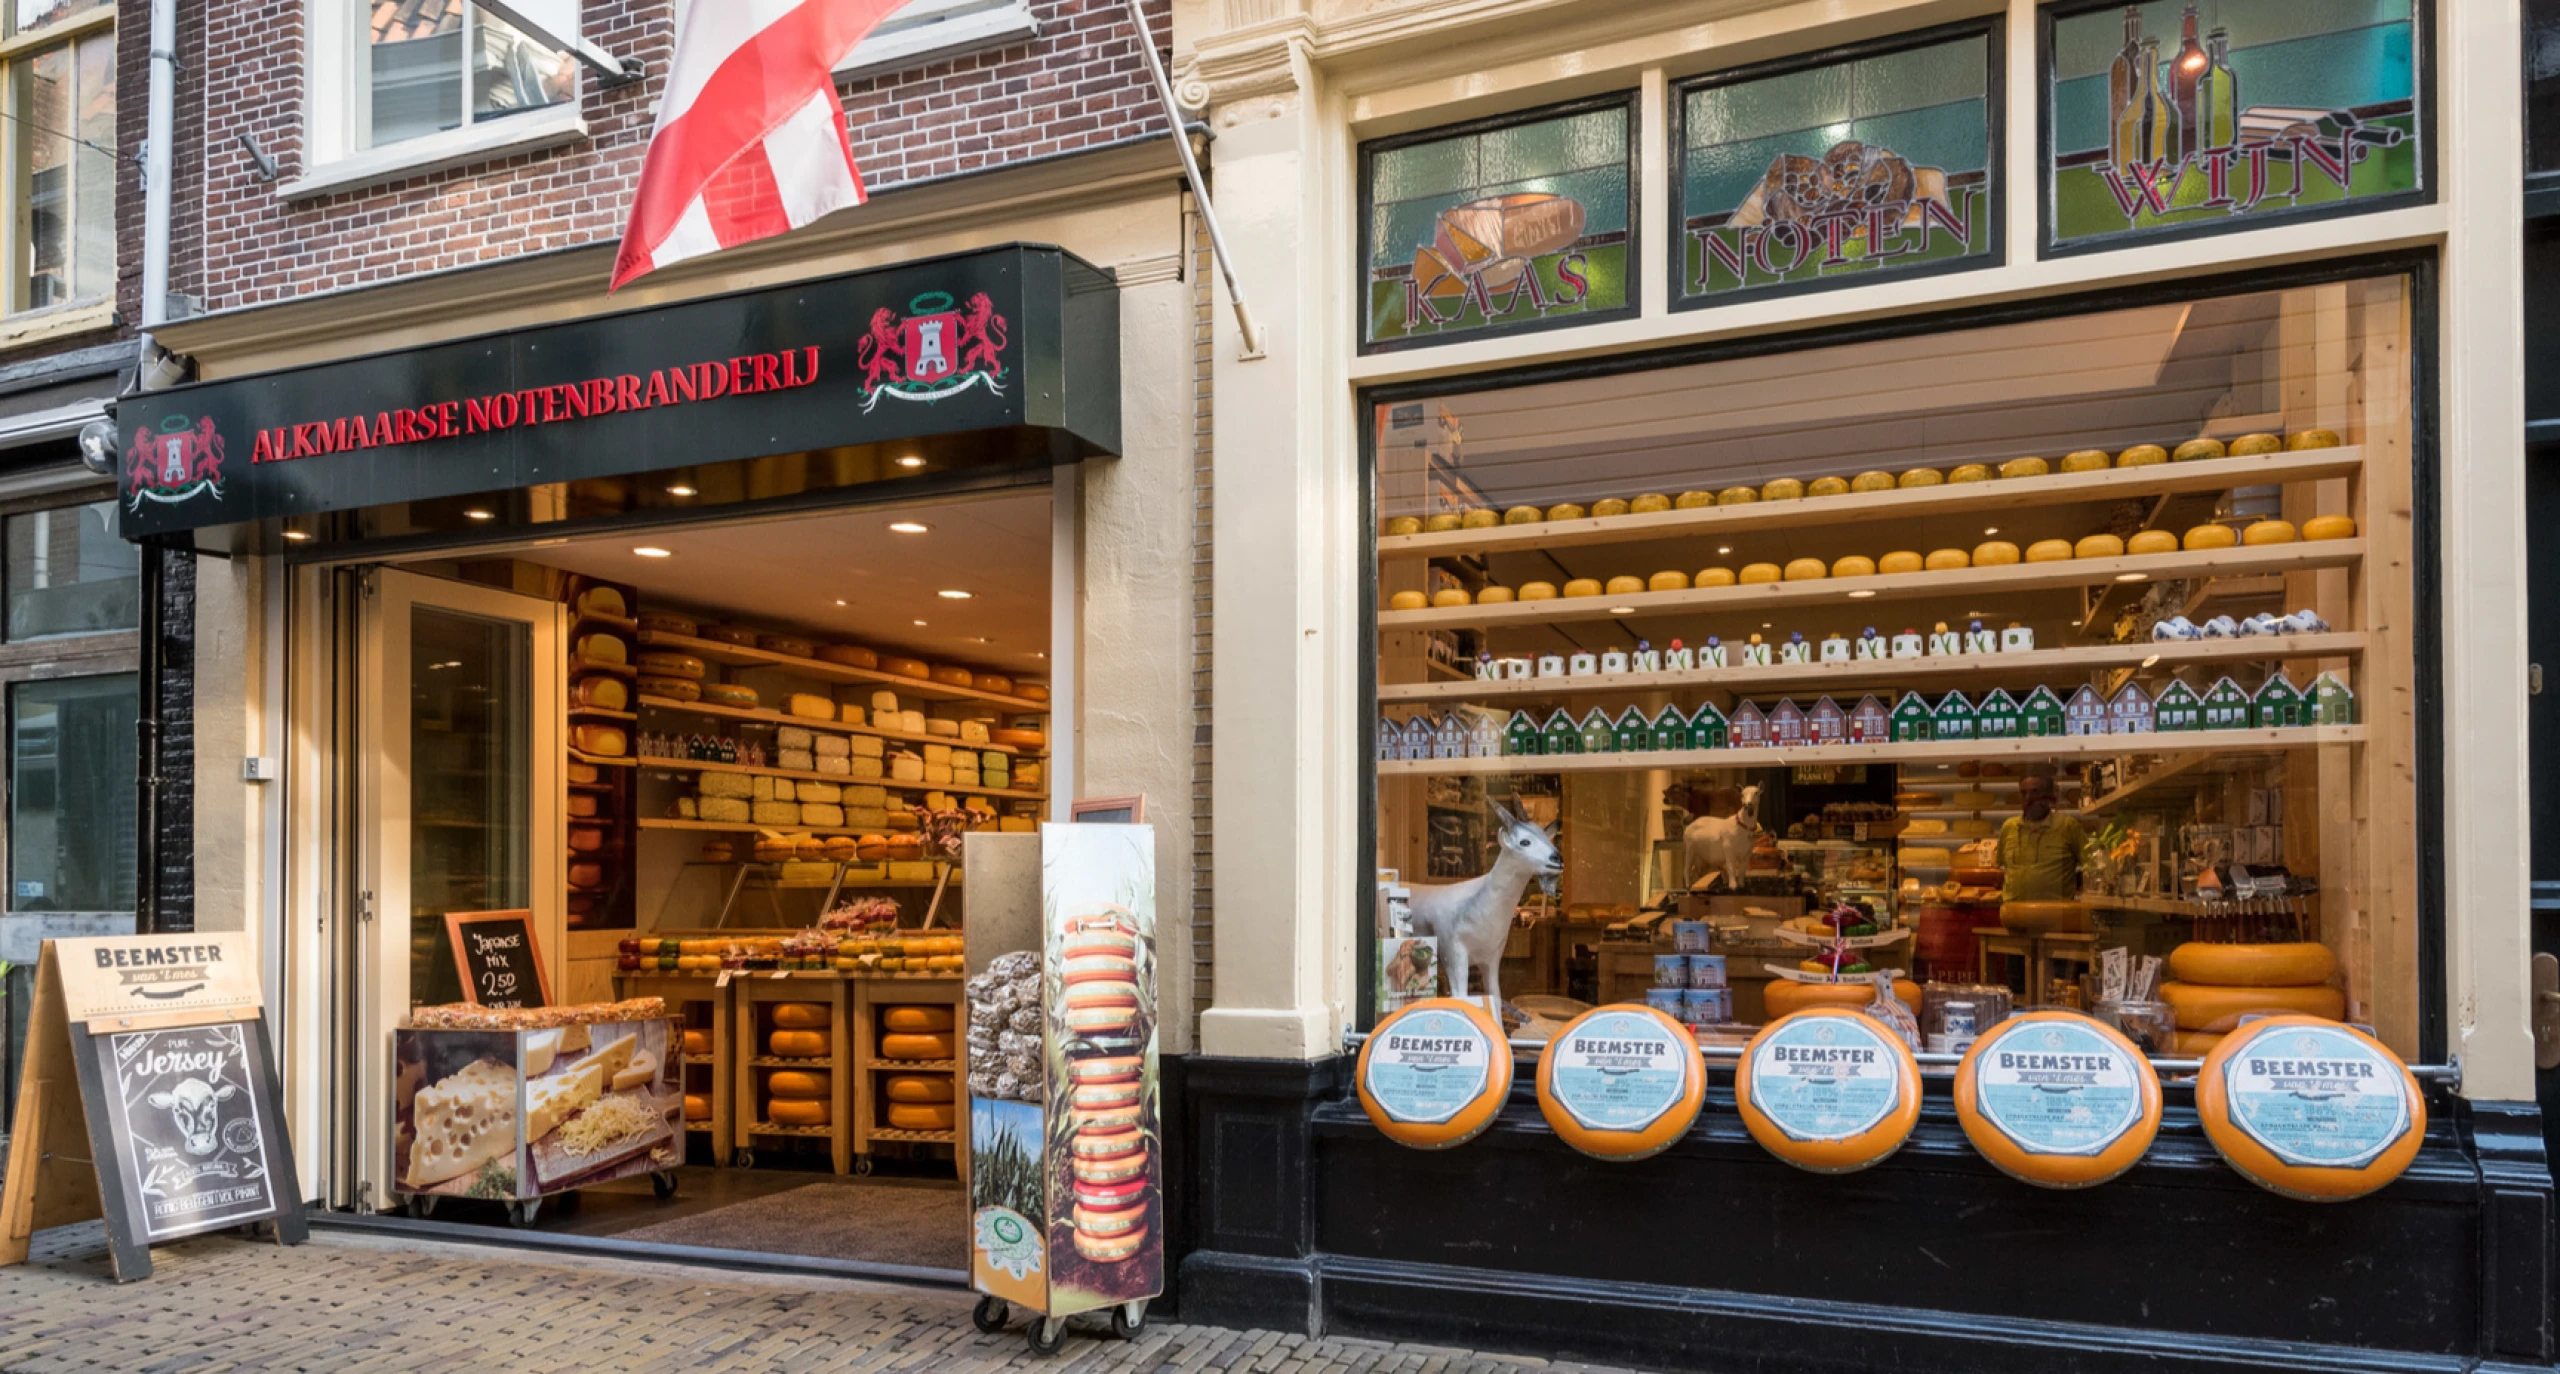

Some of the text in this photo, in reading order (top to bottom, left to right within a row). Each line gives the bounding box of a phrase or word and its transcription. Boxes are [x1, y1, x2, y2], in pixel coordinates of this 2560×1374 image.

[2092, 126, 2362, 219] WIJN
[1695, 187, 1987, 287] NOTEN
[1401, 254, 1589, 329] KAAS
[251, 345, 820, 464] ALKMAARSE NOTENBRANDERIJ
[94, 945, 223, 968] BEEMSTER
[1389, 1036, 1473, 1052] BEEMSTER
[1574, 1039, 1666, 1055] BEEMSTER
[1774, 1046, 1875, 1063] BEEMSTER
[135, 1049, 228, 1084] Jersey
[2000, 1053, 2112, 1071] BEEMSTER
[2251, 1059, 2374, 1078] BEEMSTER
